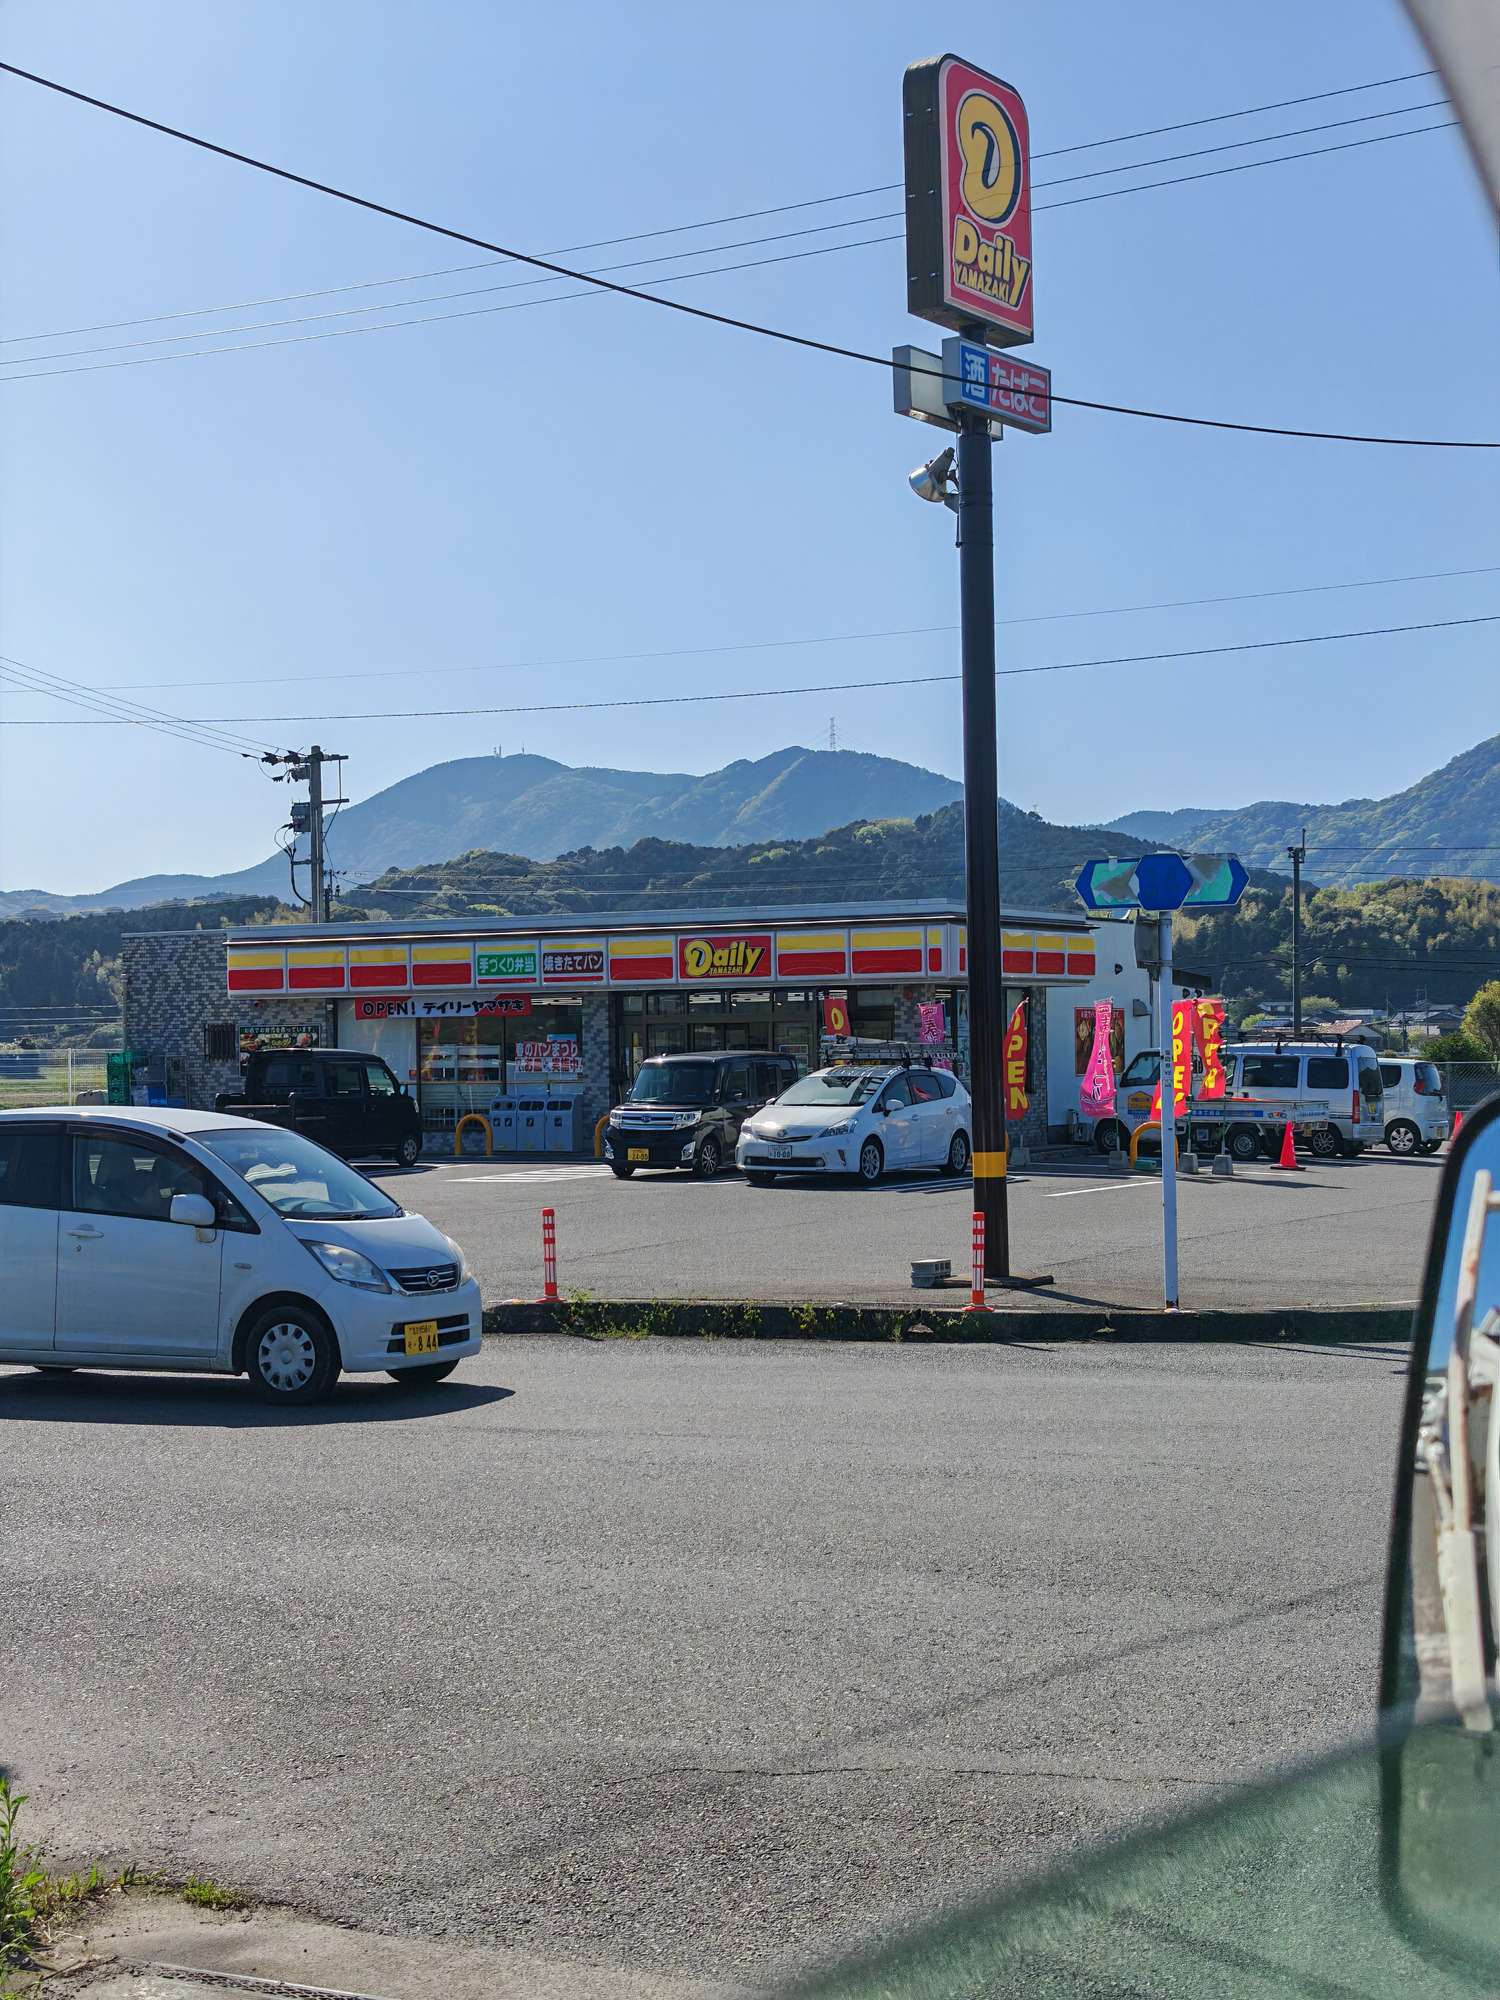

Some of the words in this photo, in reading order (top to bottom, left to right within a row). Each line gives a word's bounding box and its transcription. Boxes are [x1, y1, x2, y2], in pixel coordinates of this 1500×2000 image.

[955, 216, 1030, 307] Daily
[955, 262, 1009, 303] YAMAZAKI
[965, 352, 986, 399] 酒
[991, 362, 1046, 420] たばこ
[479, 955, 535, 974] 手づくり弁当
[543, 953, 603, 972] 焼きたてパン
[685, 940, 765, 976] Daily
[710, 966, 743, 975] YAMAZAKI
[362, 1001, 416, 1016] OPEN!
[422, 999, 526, 1015] デイリーヤマザキ
[774, 1150, 791, 1158] 10-00
